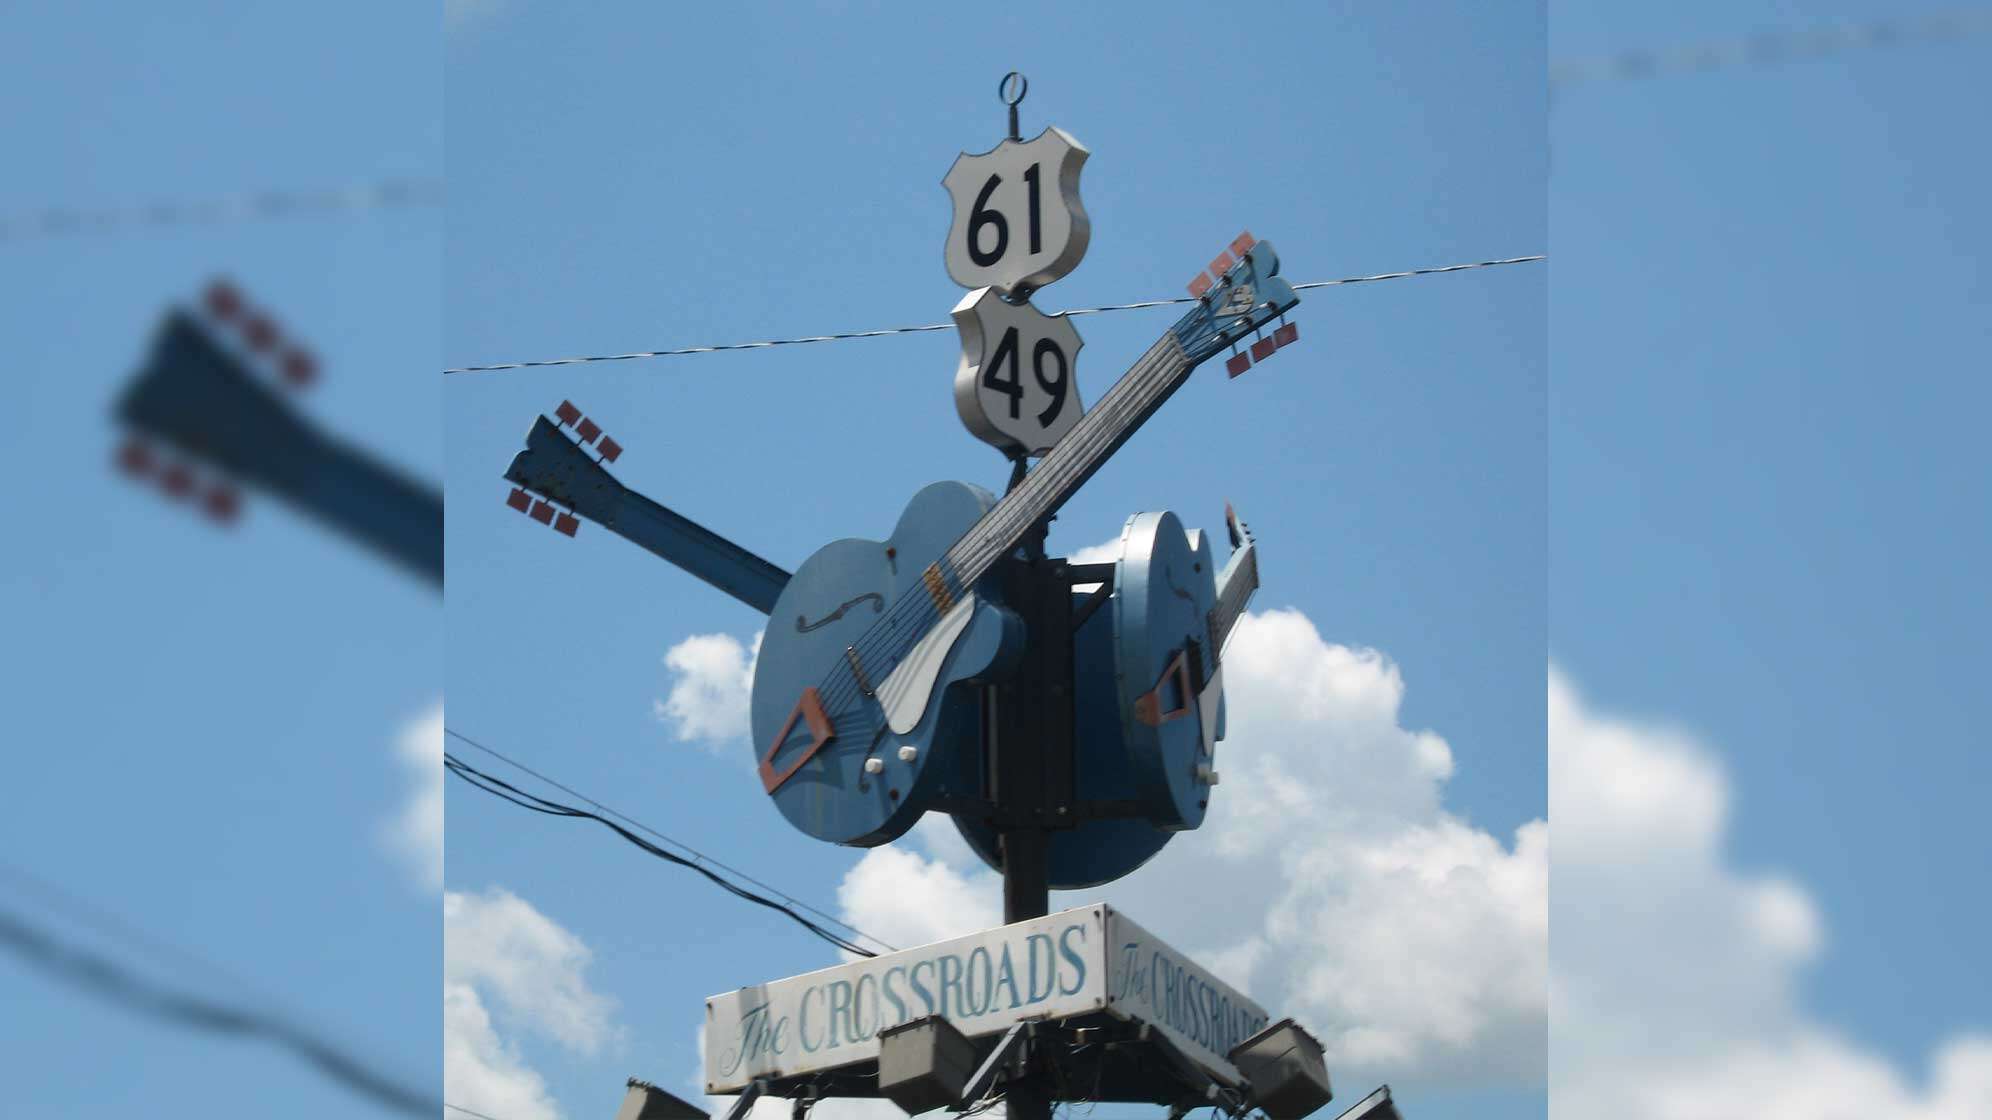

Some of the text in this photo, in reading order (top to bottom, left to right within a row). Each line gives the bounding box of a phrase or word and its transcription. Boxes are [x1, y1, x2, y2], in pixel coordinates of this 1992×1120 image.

[967, 162, 1042, 267] 61
[983, 325, 1068, 429] 49
[719, 924, 1087, 1077] The CROSSROADS
[1118, 943, 1148, 1003] The
